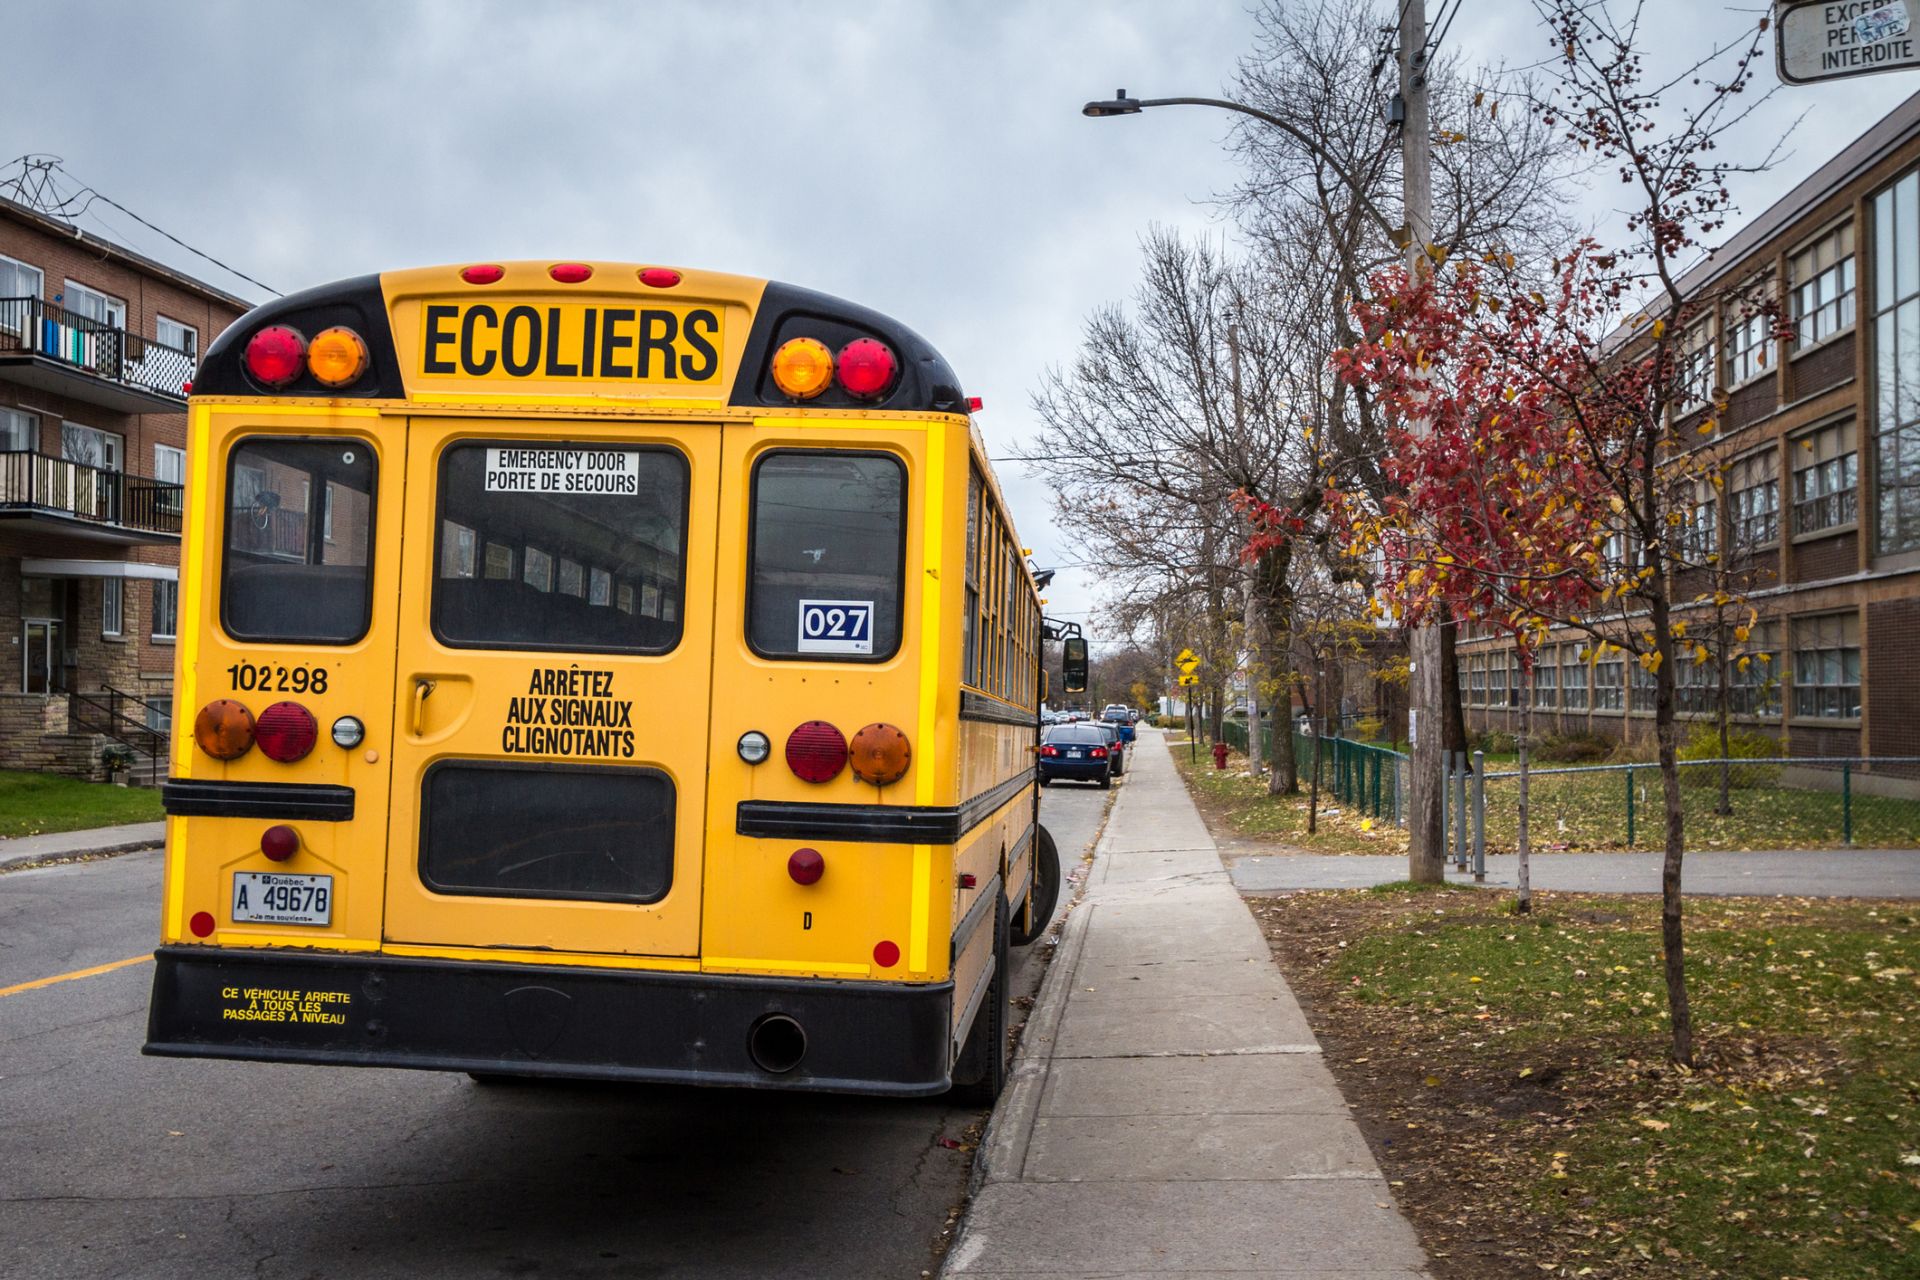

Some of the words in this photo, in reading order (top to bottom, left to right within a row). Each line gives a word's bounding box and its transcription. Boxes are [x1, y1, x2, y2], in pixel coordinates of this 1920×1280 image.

[1825, 0, 1899, 24] EXCEP
[1822, 40, 1914, 69] INTERDITE
[423, 305, 719, 382] ECOLIERS
[499, 450, 583, 470] EMERGENCY
[587, 452, 626, 471] DOOR
[487, 471, 536, 490] PORTE
[541, 472, 561, 490] DE
[565, 473, 636, 493] SECOURS
[805, 608, 867, 637] 027
[227, 664, 328, 695] 102298
[528, 663, 614, 698] ARRÊTEZ
[506, 697, 547, 725] AUX
[550, 698, 633, 728] SIGNAUX
[502, 726, 635, 758] CLIGNOTANTS
[271, 877, 305, 886] Québec
[237, 884, 248, 910] A
[263, 886, 328, 912] 49678
[803, 911, 813, 930] D
[222, 987, 239, 999] CE
[223, 1009, 286, 1022] PASSAGES
[302, 1012, 346, 1025] NIVEAU
[263, 1000, 295, 1011] TOUS
[298, 1001, 322, 1013] LES
